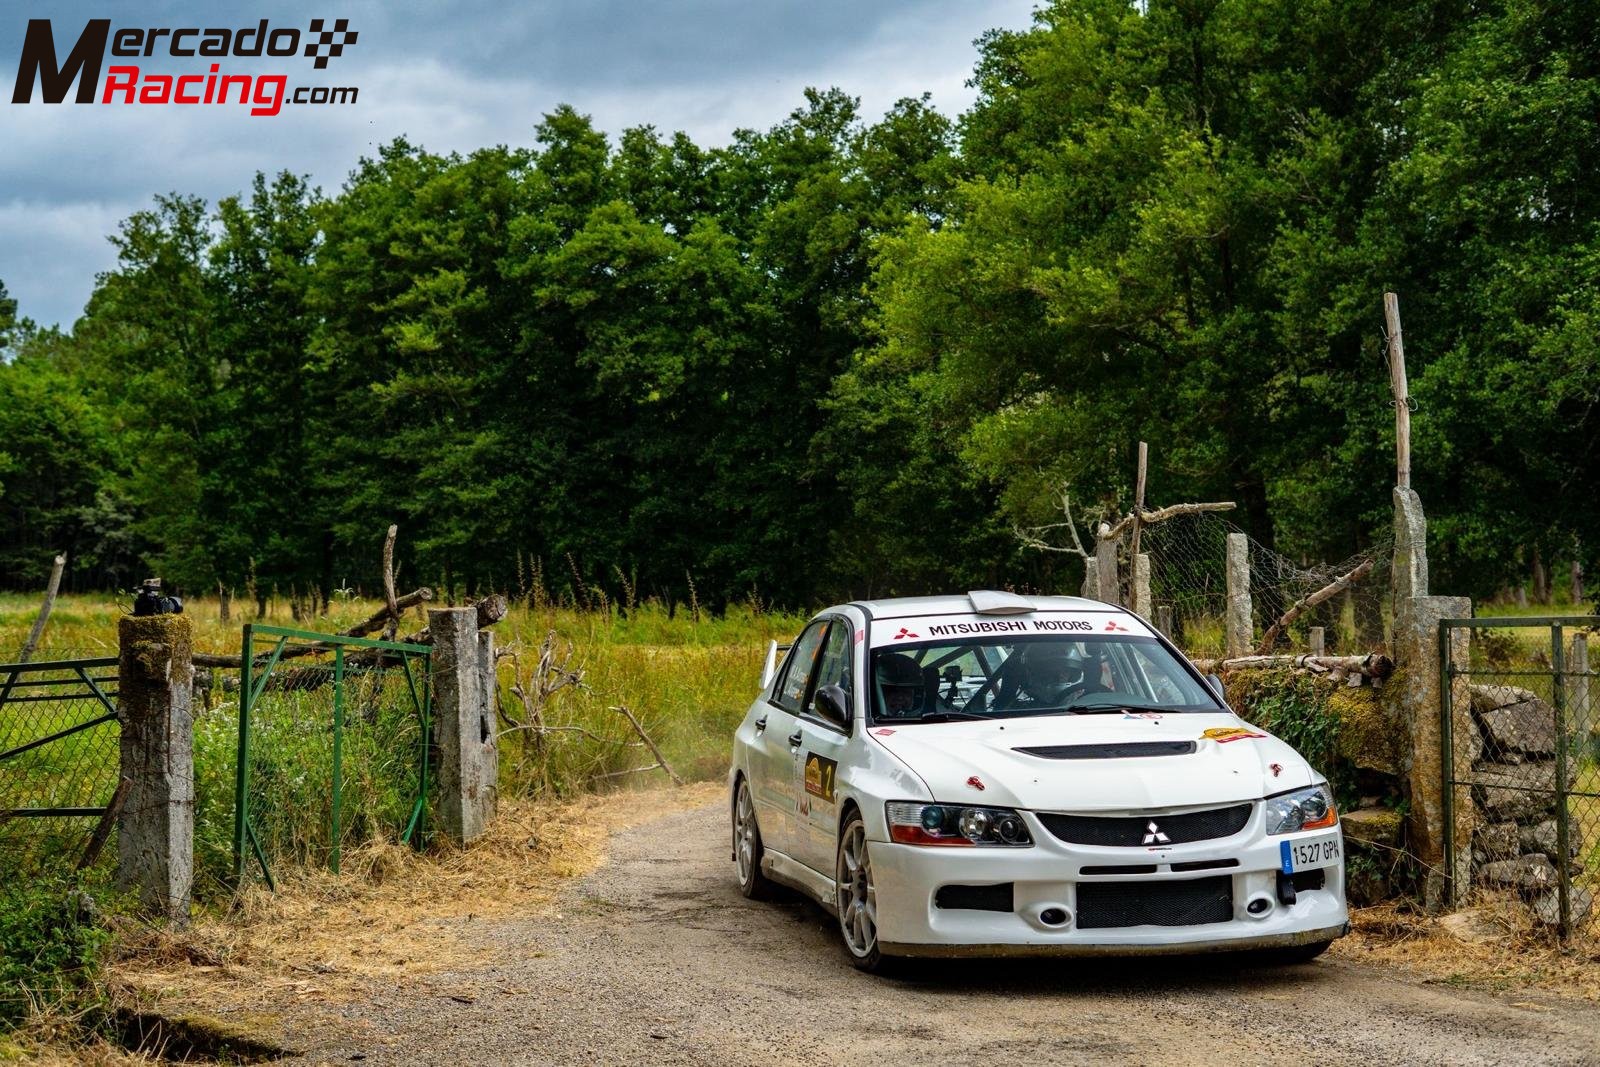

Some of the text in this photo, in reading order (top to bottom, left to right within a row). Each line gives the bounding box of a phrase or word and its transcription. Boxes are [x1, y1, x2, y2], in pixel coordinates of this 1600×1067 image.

[929, 620, 1093, 636] MITSUBISHI MOTORS
[1293, 840, 1340, 865] 1527 GPN
